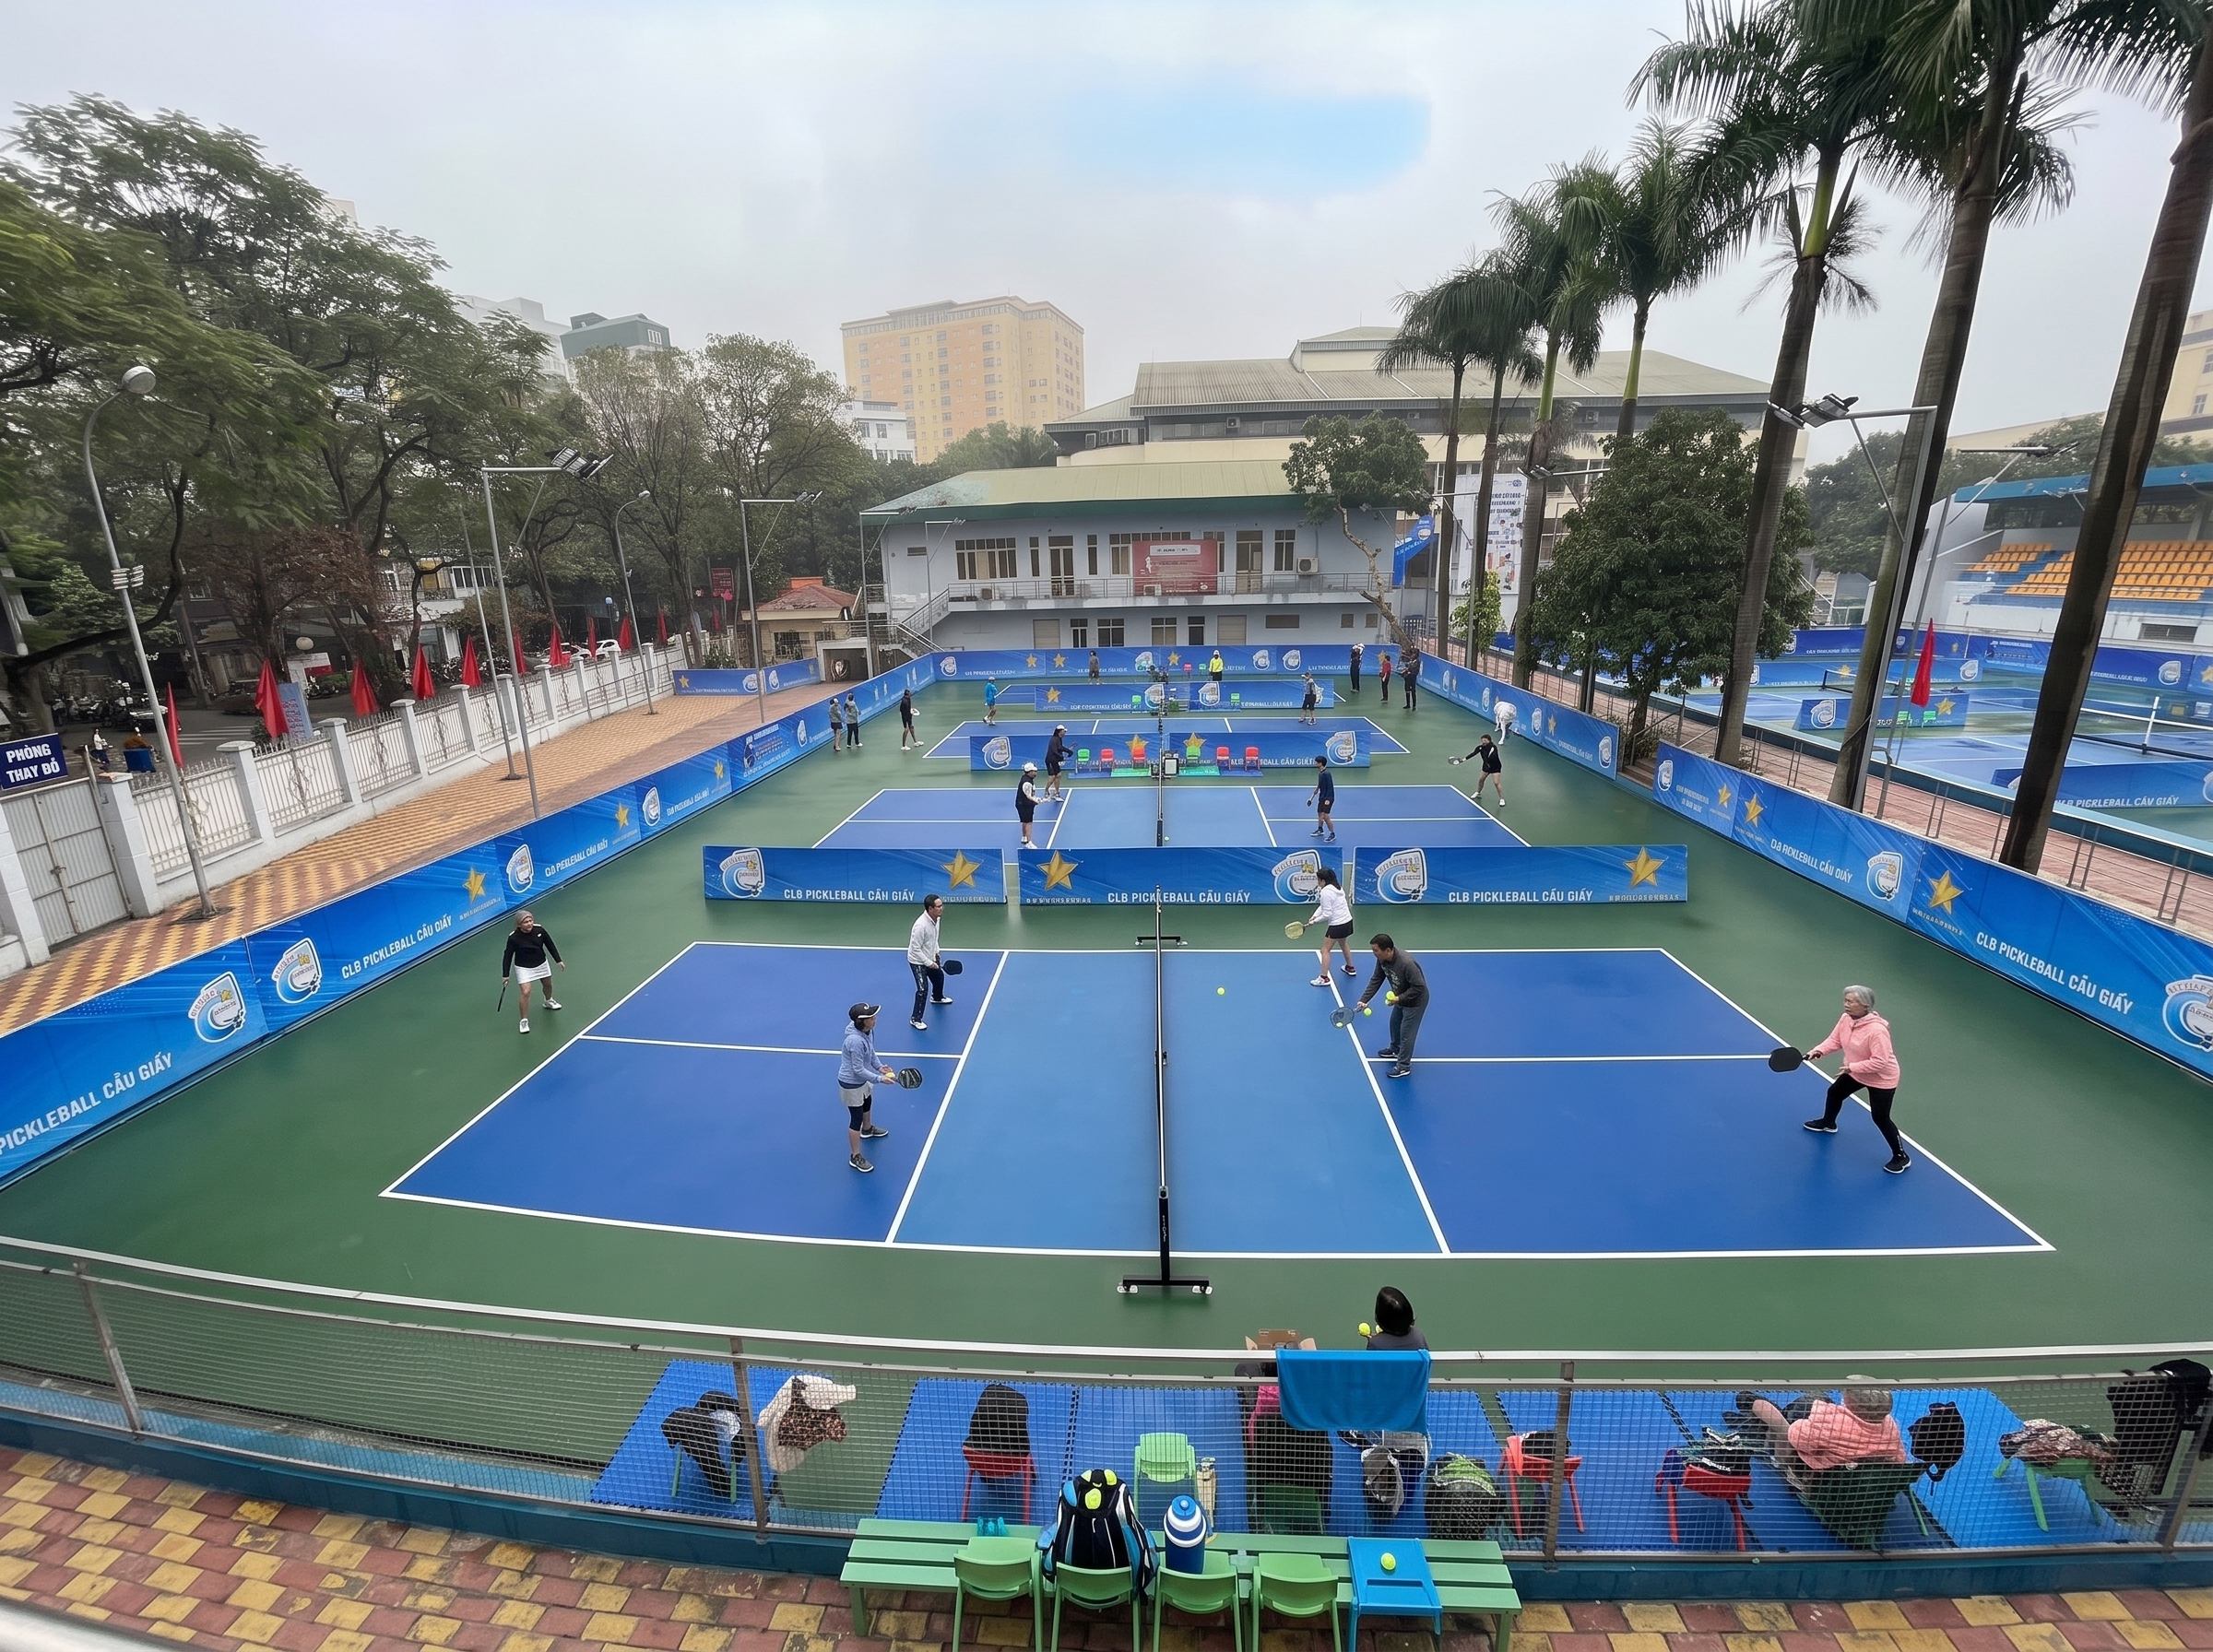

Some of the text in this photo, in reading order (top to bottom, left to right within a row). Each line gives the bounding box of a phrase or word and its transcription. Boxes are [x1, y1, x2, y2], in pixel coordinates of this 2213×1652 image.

[6, 743, 52, 763] PHÒNG
[6, 764, 39, 784] THAY
[806, 890, 865, 901] PICKLEBALL
[1107, 892, 1129, 903] CLB
[1449, 891, 1470, 903] CLB
[1473, 891, 1539, 903] PICKLEBALL
[341, 958, 361, 979] CLB
[362, 934, 416, 969] PICKLEBALL
[1976, 931, 1997, 951] CLB
[1998, 941, 2065, 985] PICKLEBALL
[138, 1051, 172, 1081] GIẤY
